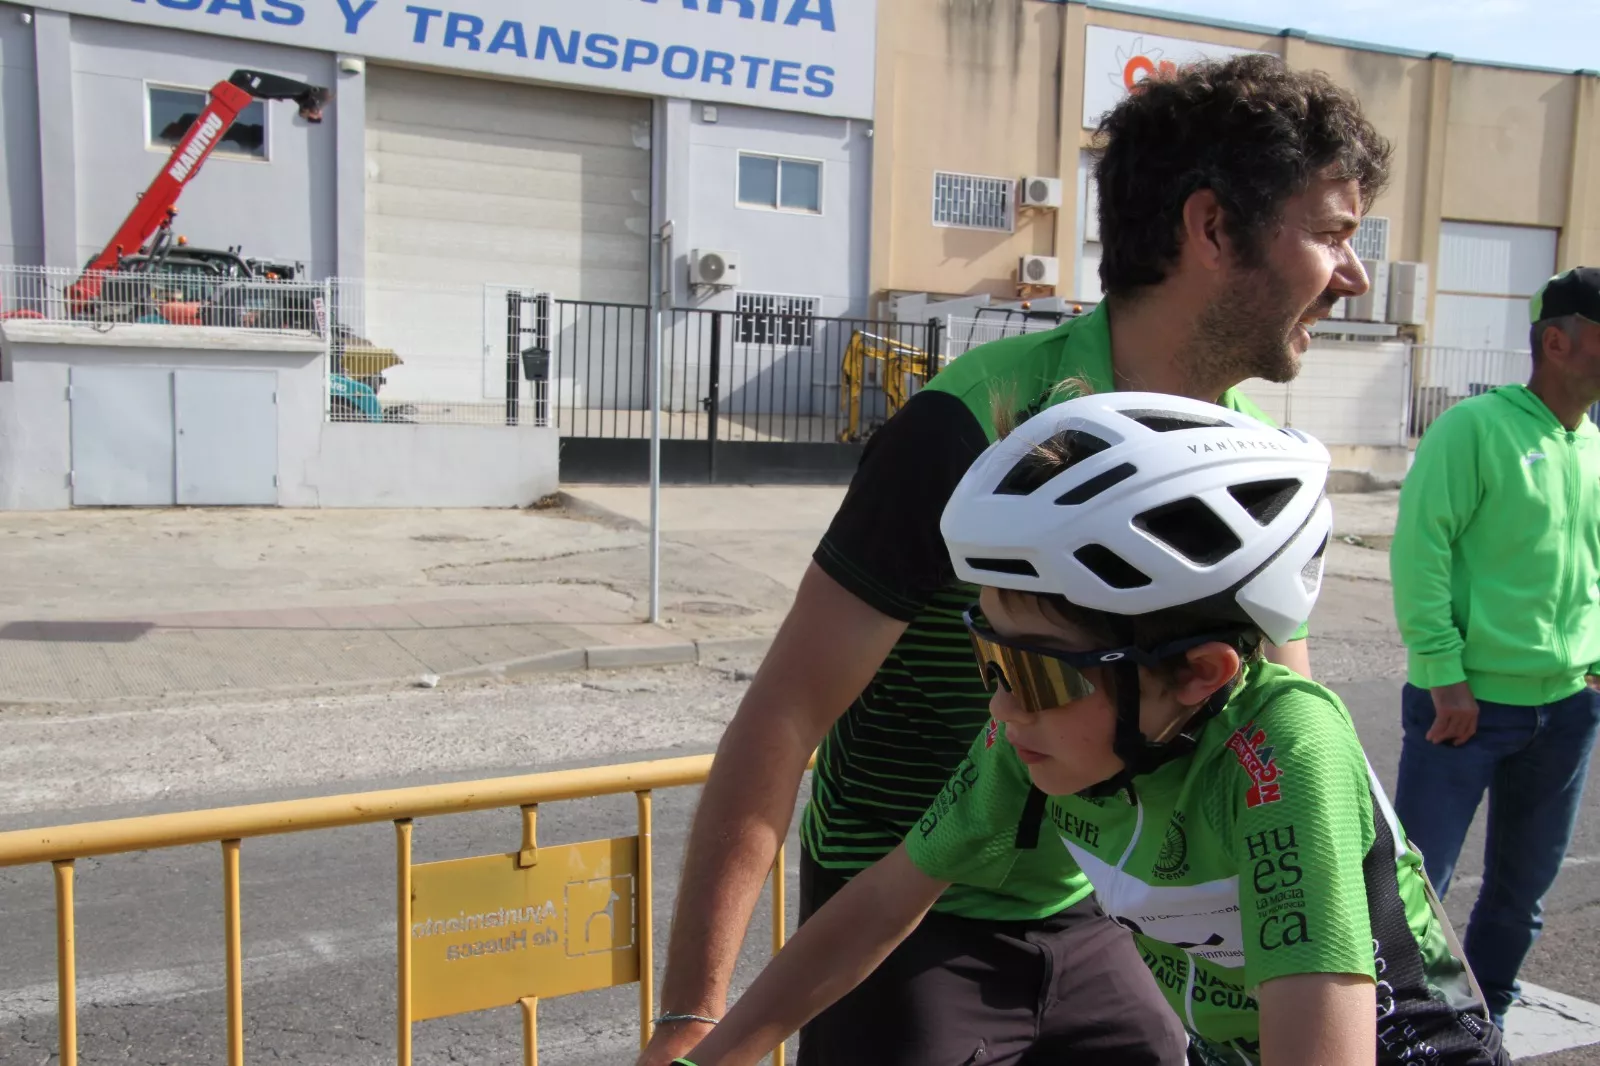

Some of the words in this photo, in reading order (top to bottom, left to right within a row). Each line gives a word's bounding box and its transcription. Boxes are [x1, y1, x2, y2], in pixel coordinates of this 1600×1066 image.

[336, 0, 378, 35] Y
[405, 5, 836, 98] TRANSPORTES
[168, 111, 223, 183] MANITOU
